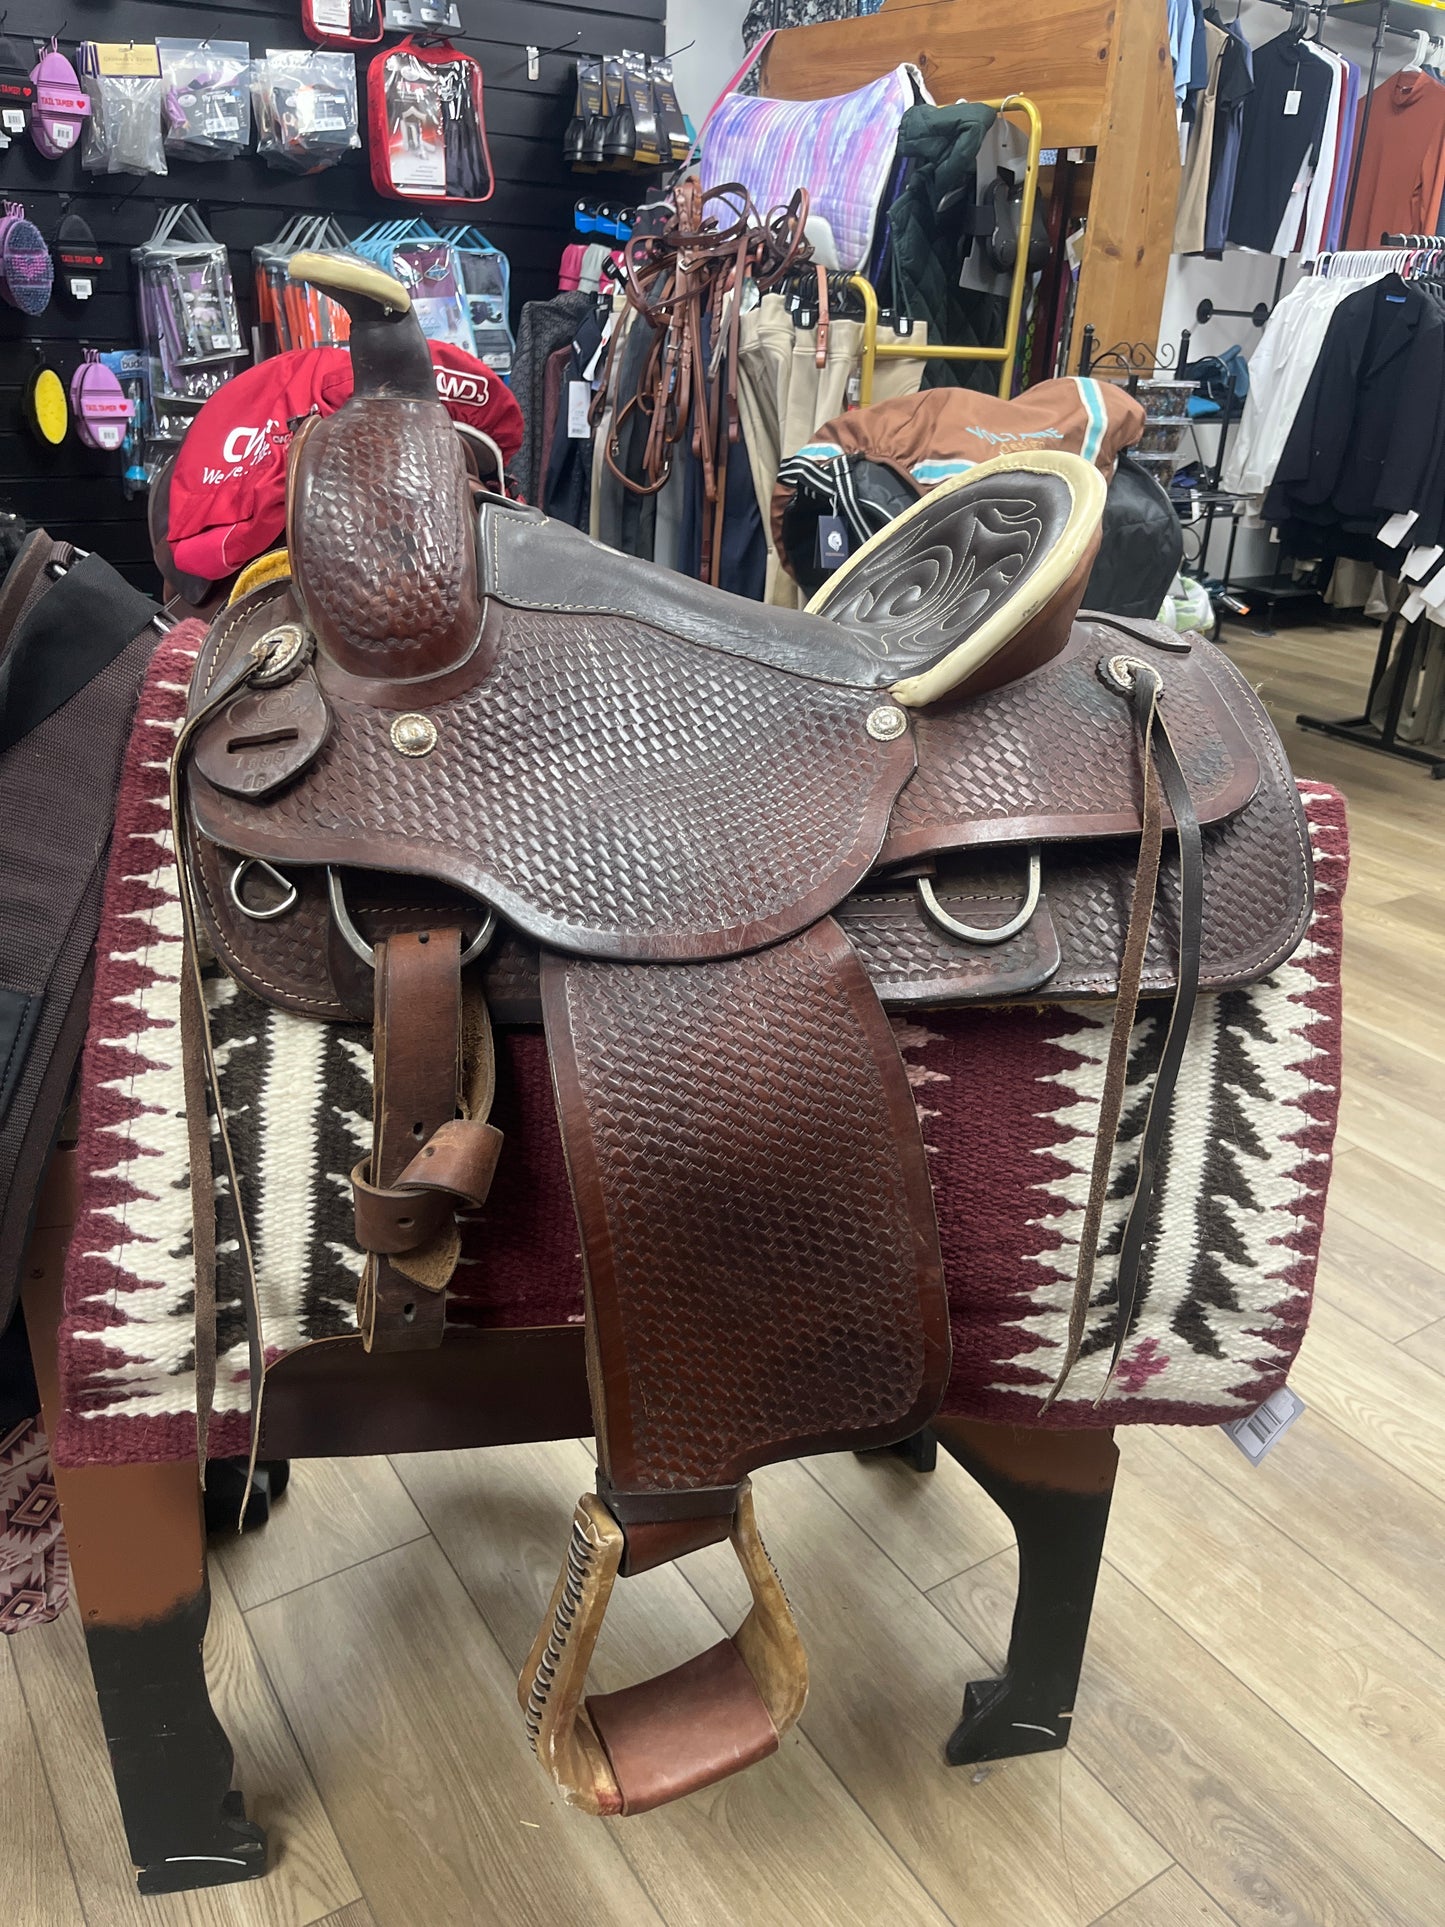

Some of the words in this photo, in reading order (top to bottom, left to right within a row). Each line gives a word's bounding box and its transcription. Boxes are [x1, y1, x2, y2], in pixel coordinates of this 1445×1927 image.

[41, 97, 54, 106] TAIL
[55, 98, 74, 108] TAMER
[61, 254, 74, 263] TAIL
[75, 255, 93, 264] TAMER
[98, 404, 117, 412] TAMER
[203, 467, 224, 485] We
